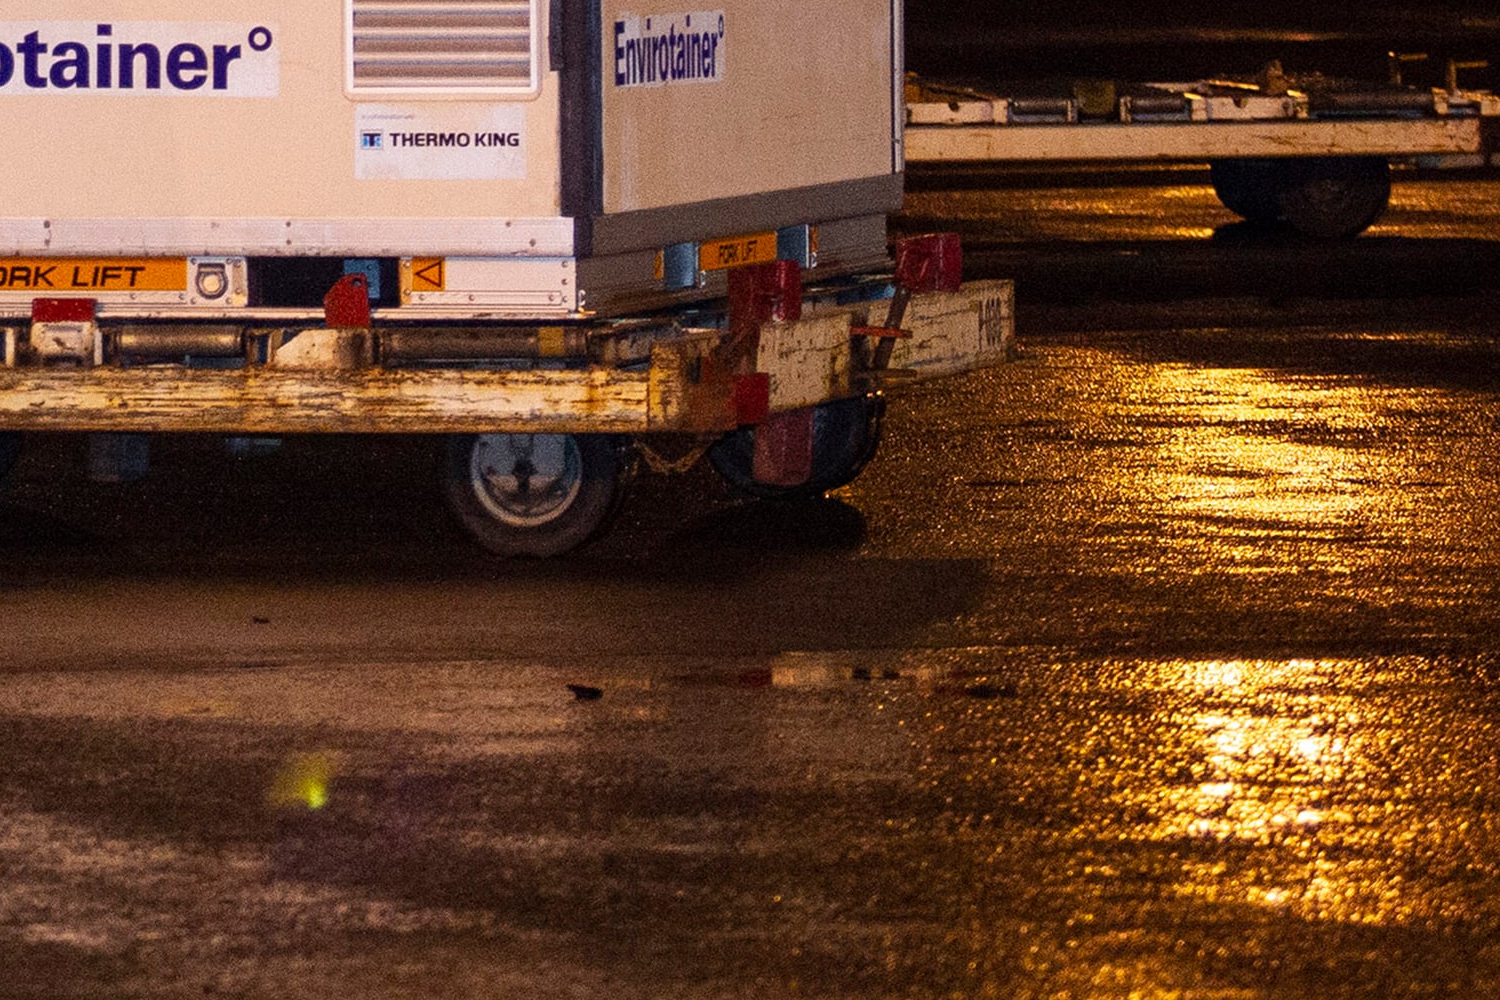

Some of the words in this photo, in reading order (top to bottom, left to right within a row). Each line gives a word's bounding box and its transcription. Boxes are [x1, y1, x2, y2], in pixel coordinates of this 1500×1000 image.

[389, 133, 470, 147] THERMO
[475, 133, 520, 147] KING
[71, 266, 146, 287] LIFT
